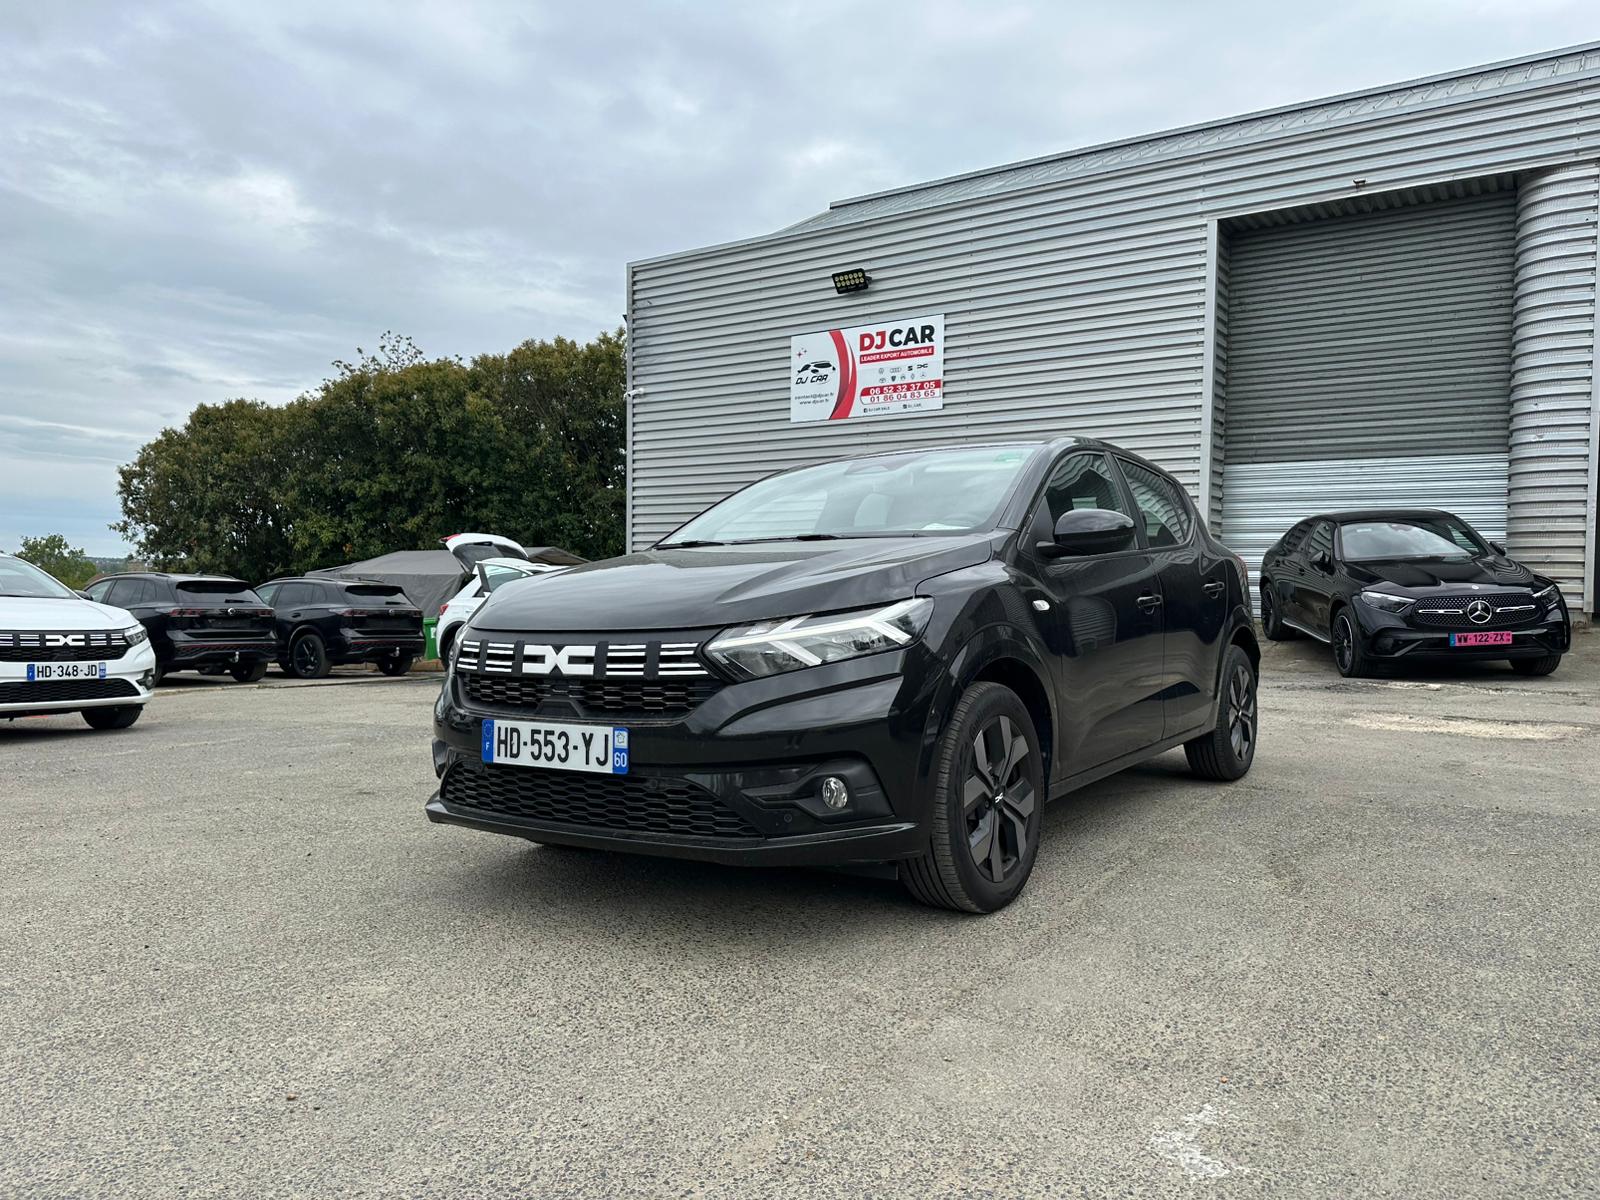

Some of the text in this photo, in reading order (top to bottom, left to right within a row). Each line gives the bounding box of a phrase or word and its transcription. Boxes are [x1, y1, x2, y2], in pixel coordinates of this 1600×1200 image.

[859, 325, 935, 352] DJ CAR
[861, 347, 932, 362] LEADER EXPORT AUTOMOBILE
[795, 374, 829, 385] DJ CAR
[896, 384, 907, 392] 32
[923, 381, 936, 389] 05
[910, 391, 921, 399] 83
[37, 664, 97, 678] HD-348-JD
[485, 742, 490, 750] F
[497, 726, 609, 767] HD-553-YJ
[614, 752, 627, 767] 60
